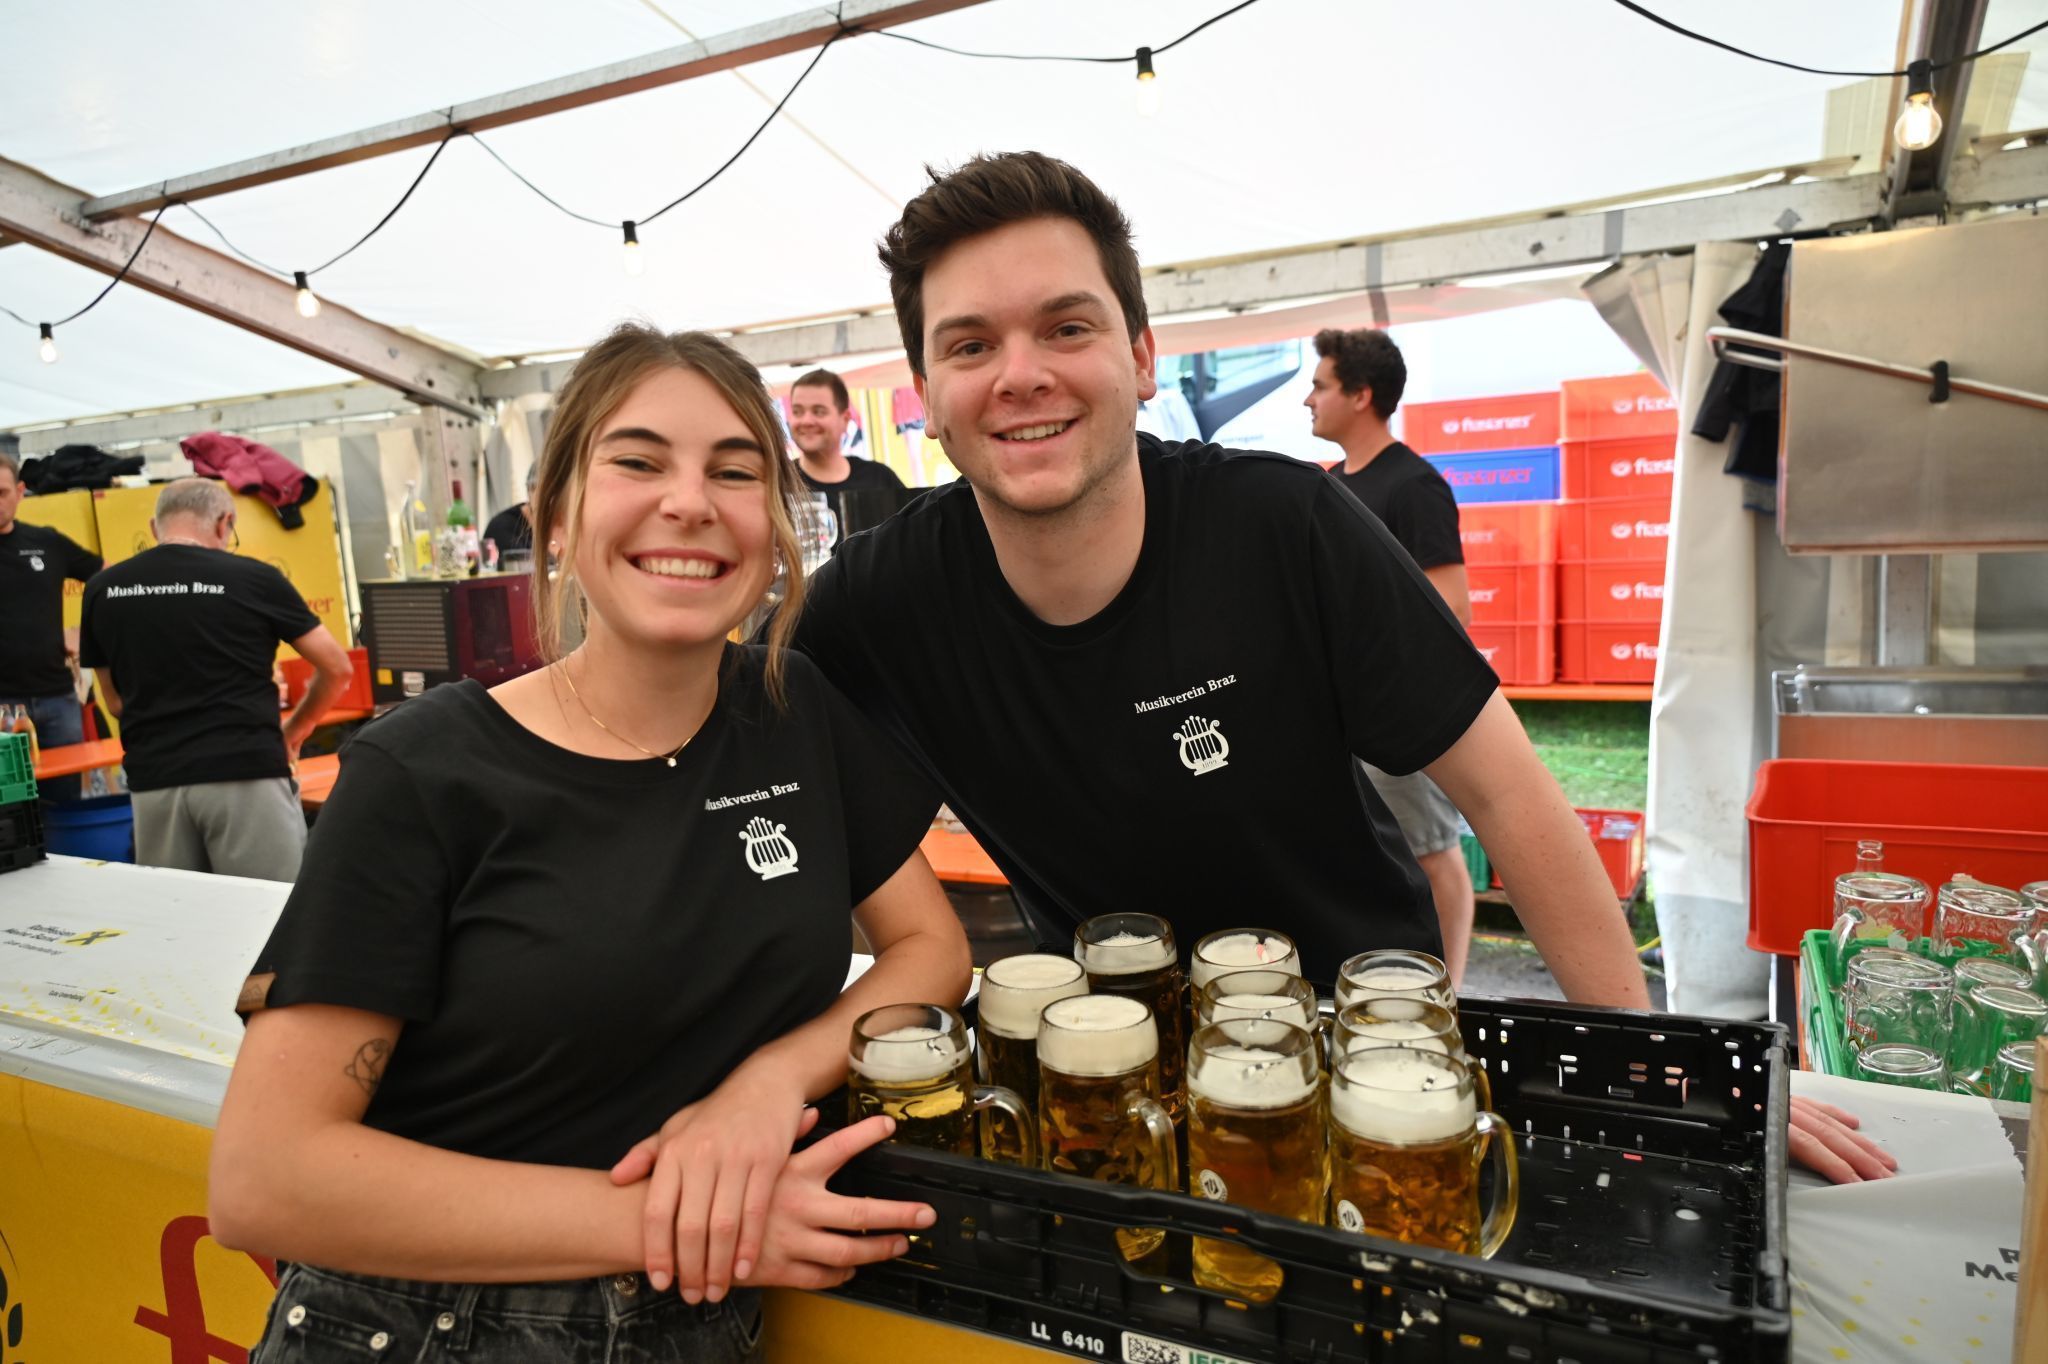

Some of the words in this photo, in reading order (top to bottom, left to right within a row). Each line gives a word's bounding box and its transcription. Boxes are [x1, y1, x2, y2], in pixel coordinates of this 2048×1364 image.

[106, 582, 188, 599] Musikverein
[192, 581, 225, 595] Braz
[1134, 686, 1206, 714] Musikverein
[1207, 674, 1237, 692] Braz
[770, 782, 801, 796] Braz
[1031, 1321, 1051, 1341] LL
[1062, 1330, 1104, 1354] 6410
